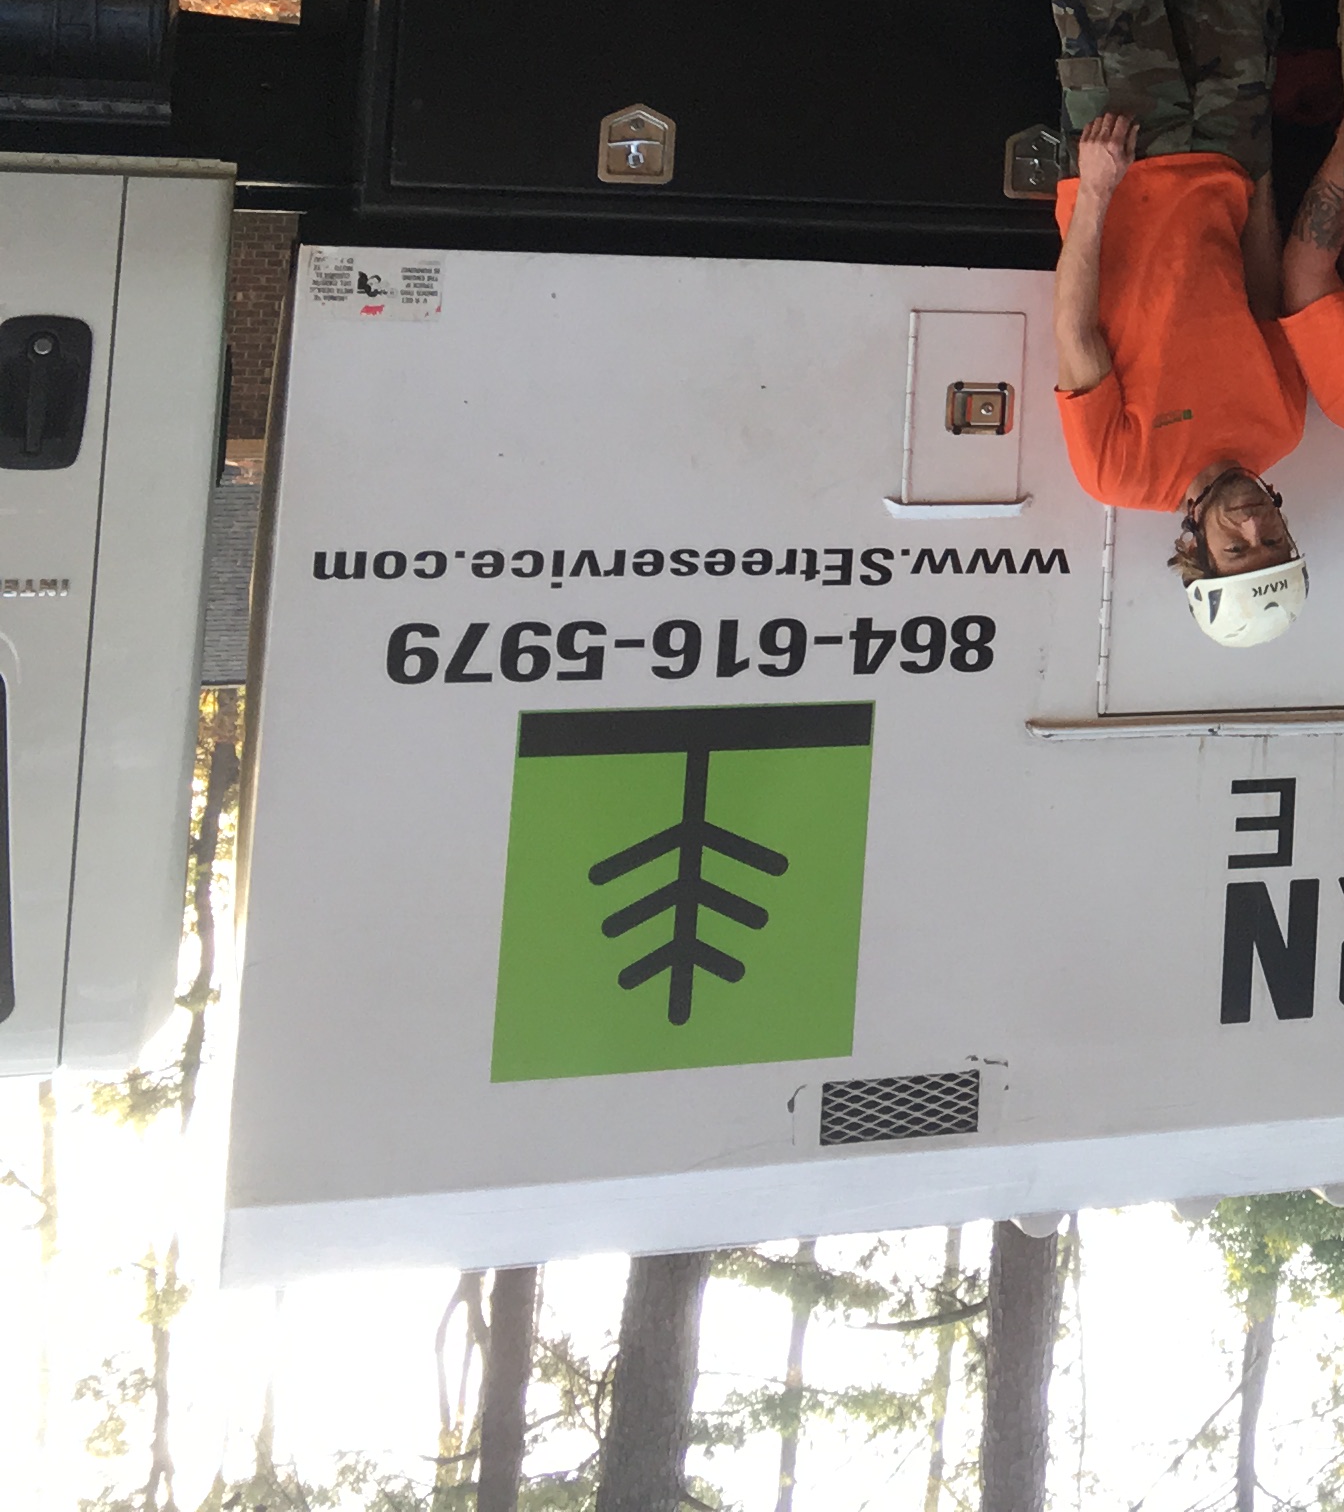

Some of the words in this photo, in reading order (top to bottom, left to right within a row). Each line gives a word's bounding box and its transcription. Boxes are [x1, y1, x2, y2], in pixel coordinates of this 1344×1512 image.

[313, 547, 1070, 588] www.SEtreeservice.com
[0, 578, 70, 598] INTE
[1252, 579, 1288, 598] KASK
[386, 615, 996, 685] 864-616-5979
